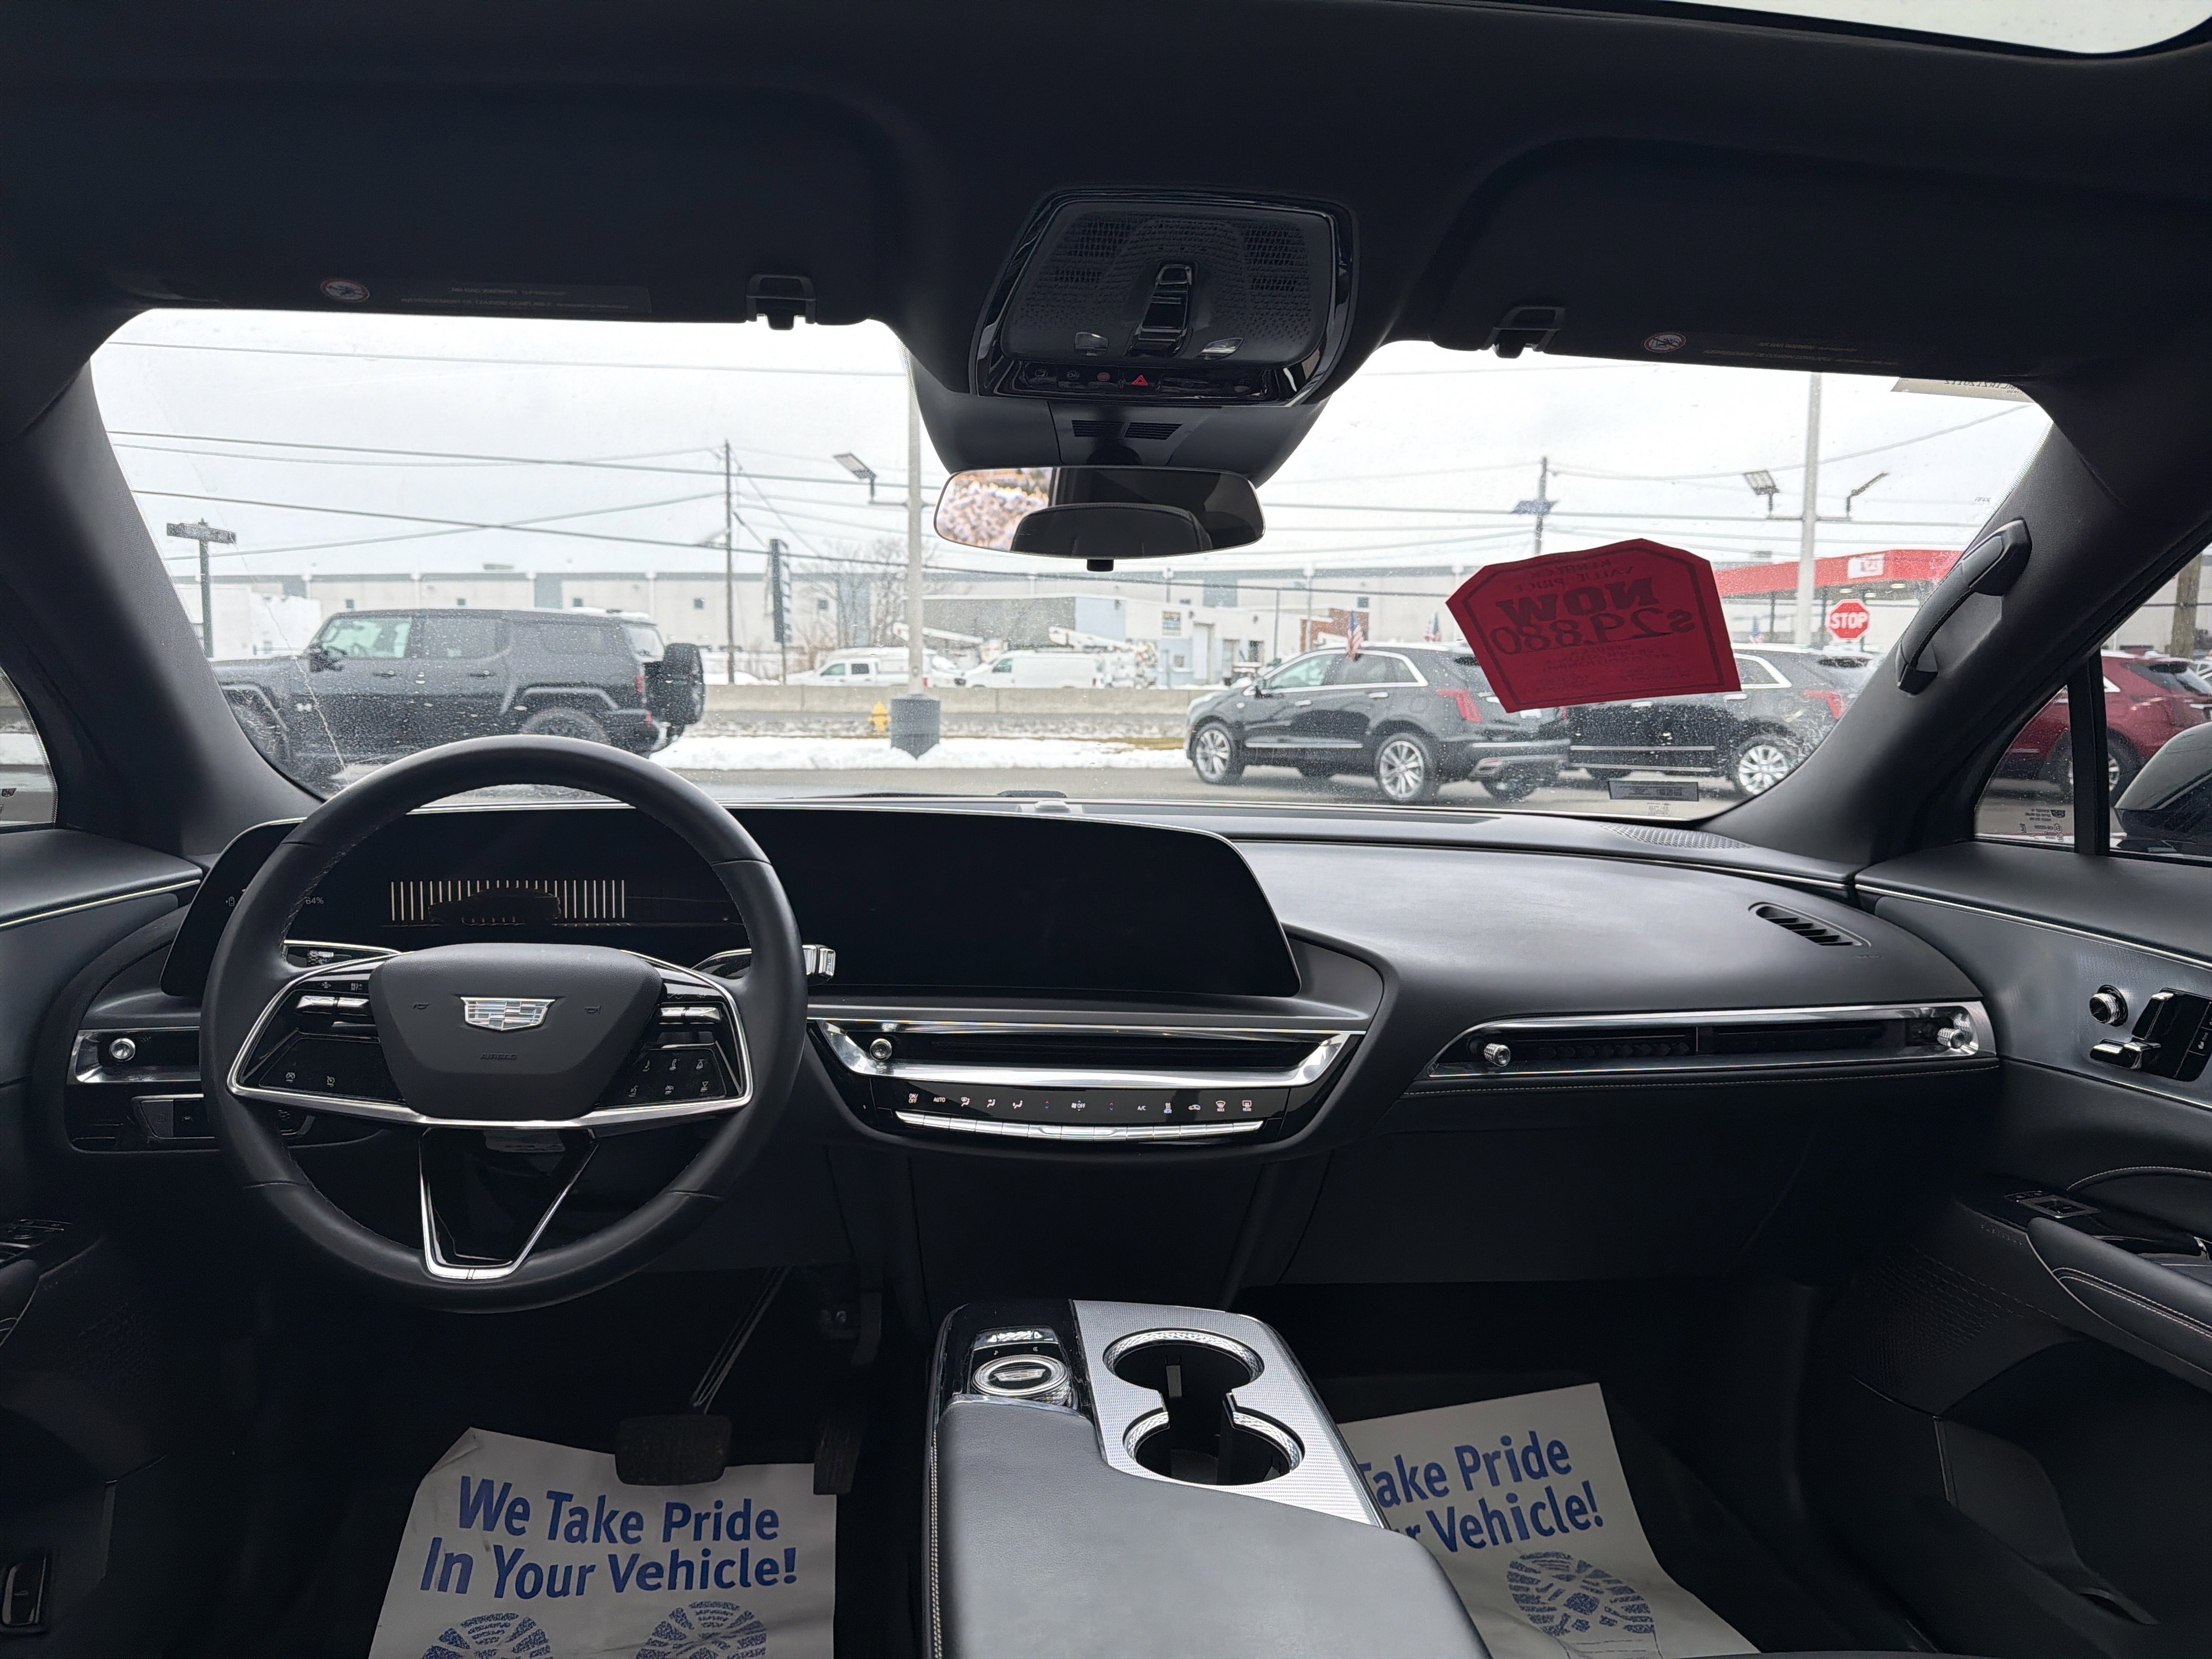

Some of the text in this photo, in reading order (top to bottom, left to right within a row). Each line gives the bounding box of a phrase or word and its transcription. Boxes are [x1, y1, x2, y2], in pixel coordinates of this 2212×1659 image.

[1830, 609, 1867, 629] STOP
[479, 1052, 518, 1060] AIRBAG
[1358, 1431, 1571, 1508] ake Pride
[459, 1475, 780, 1544] We Take Pride
[1426, 1480, 1603, 1553] Vehicle!
[420, 1538, 797, 1599] In Your Vehicle!
